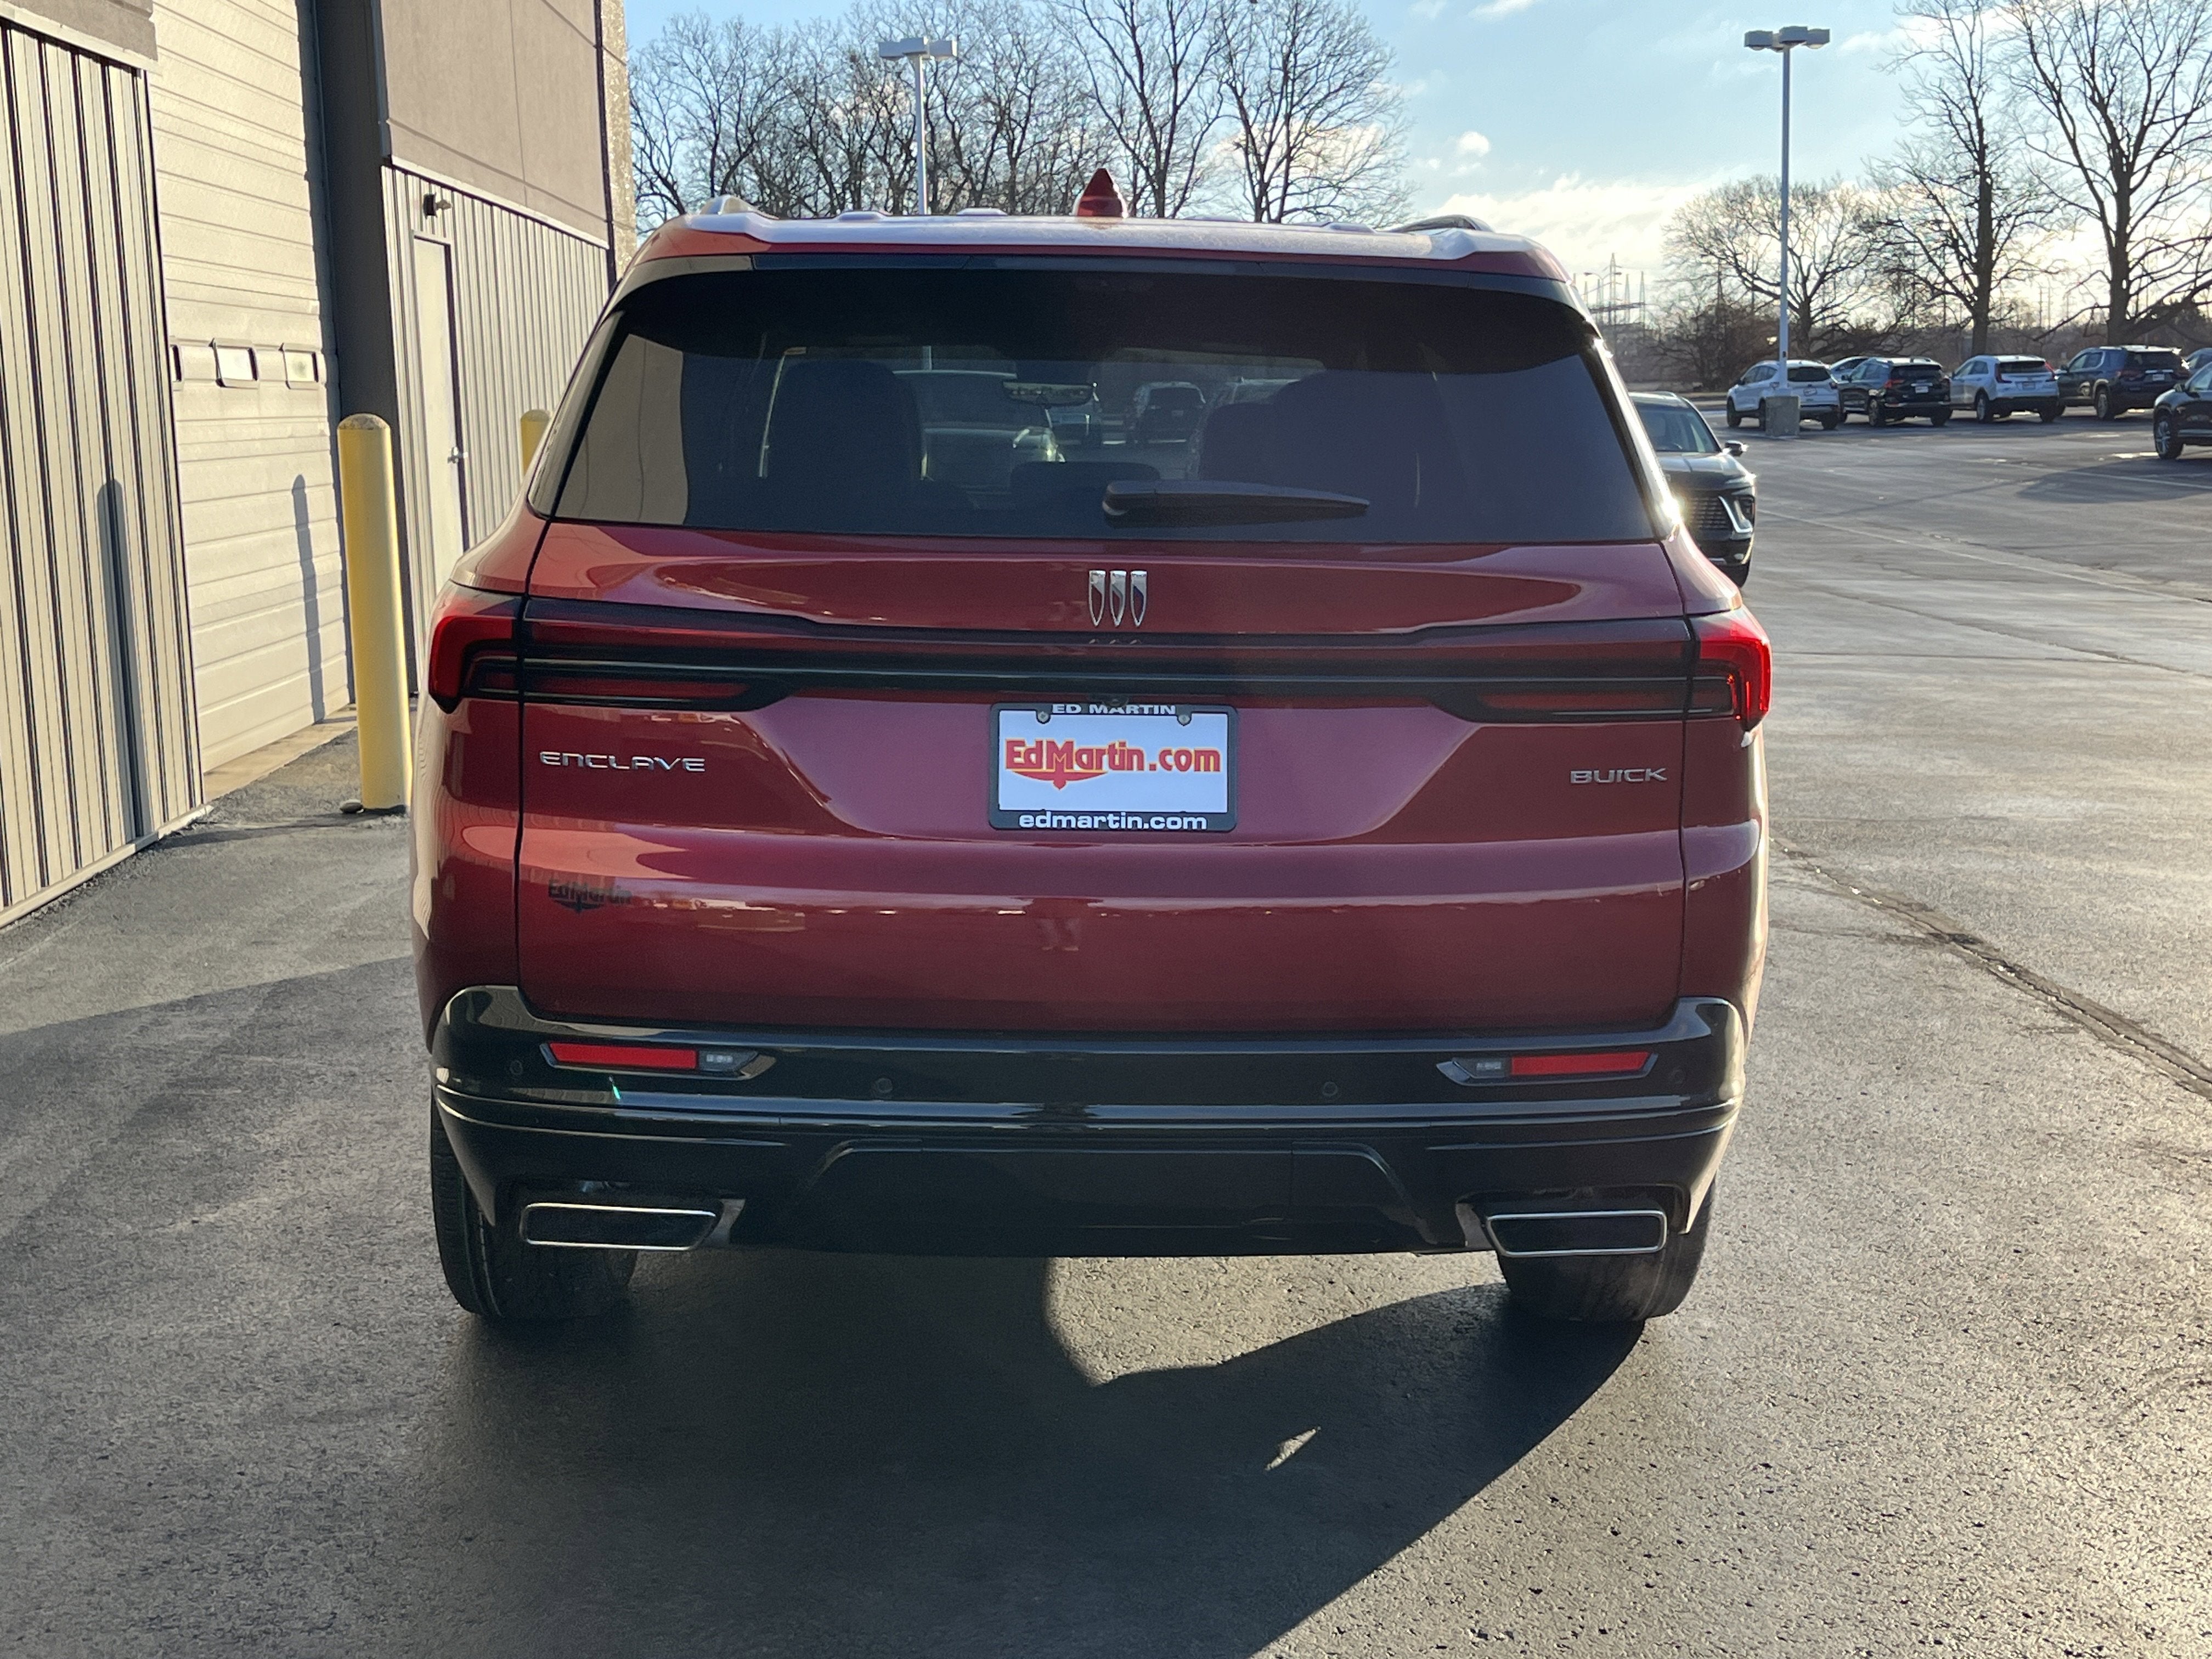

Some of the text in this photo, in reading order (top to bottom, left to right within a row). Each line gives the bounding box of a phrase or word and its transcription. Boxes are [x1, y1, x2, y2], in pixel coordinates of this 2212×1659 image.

[1052, 704, 1175, 714] ED MARTIN
[540, 751, 706, 772] ENCLAVE
[1005, 739, 1221, 772] EdMartin.com
[1570, 768, 1668, 784] BUICK
[1019, 812, 1207, 830] edmartin.com
